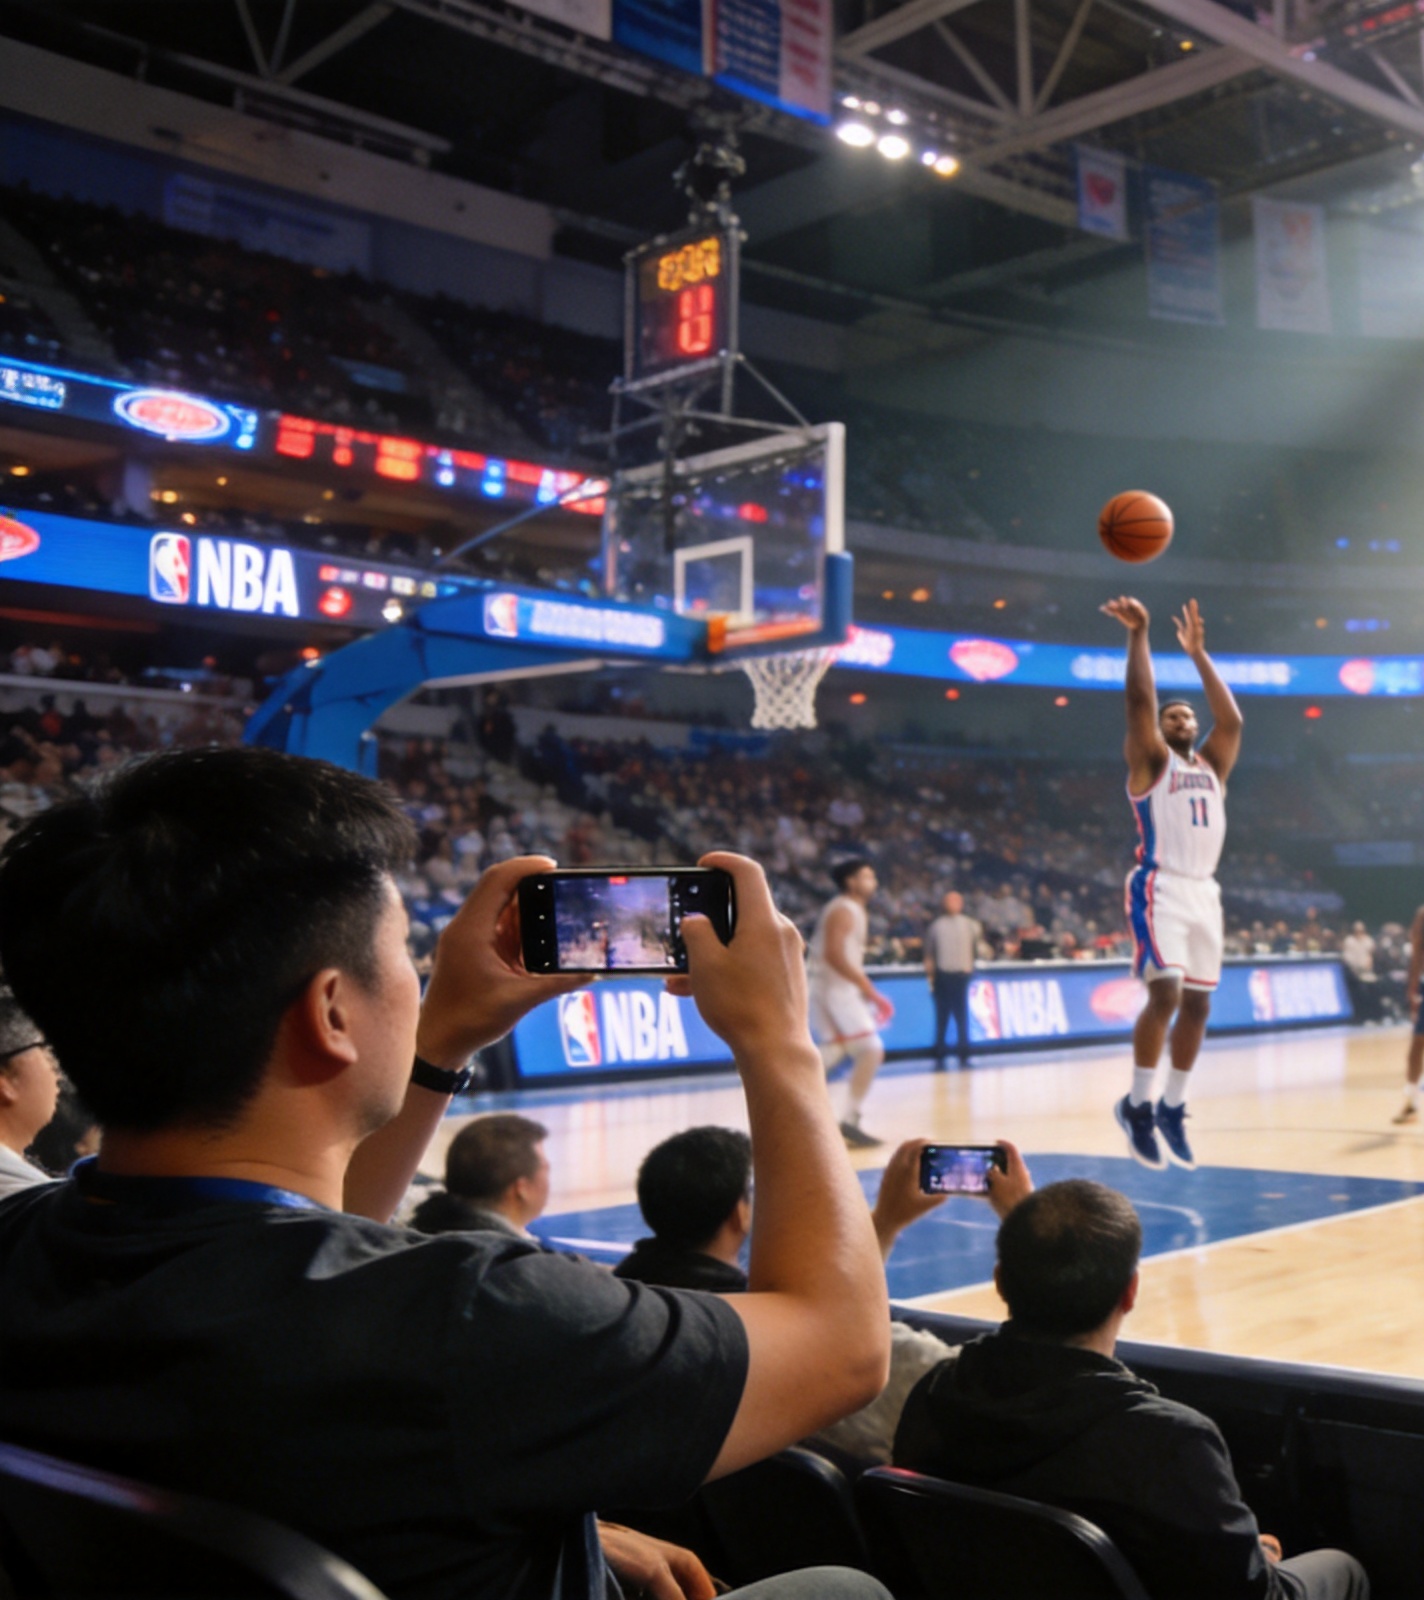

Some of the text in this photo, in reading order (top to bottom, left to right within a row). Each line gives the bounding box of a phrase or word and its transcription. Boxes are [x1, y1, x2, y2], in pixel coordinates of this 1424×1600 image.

[197, 537, 300, 618] NBA
[1189, 797, 1209, 828] 11
[602, 990, 689, 1064] NBA
[997, 979, 1069, 1039] NBA
